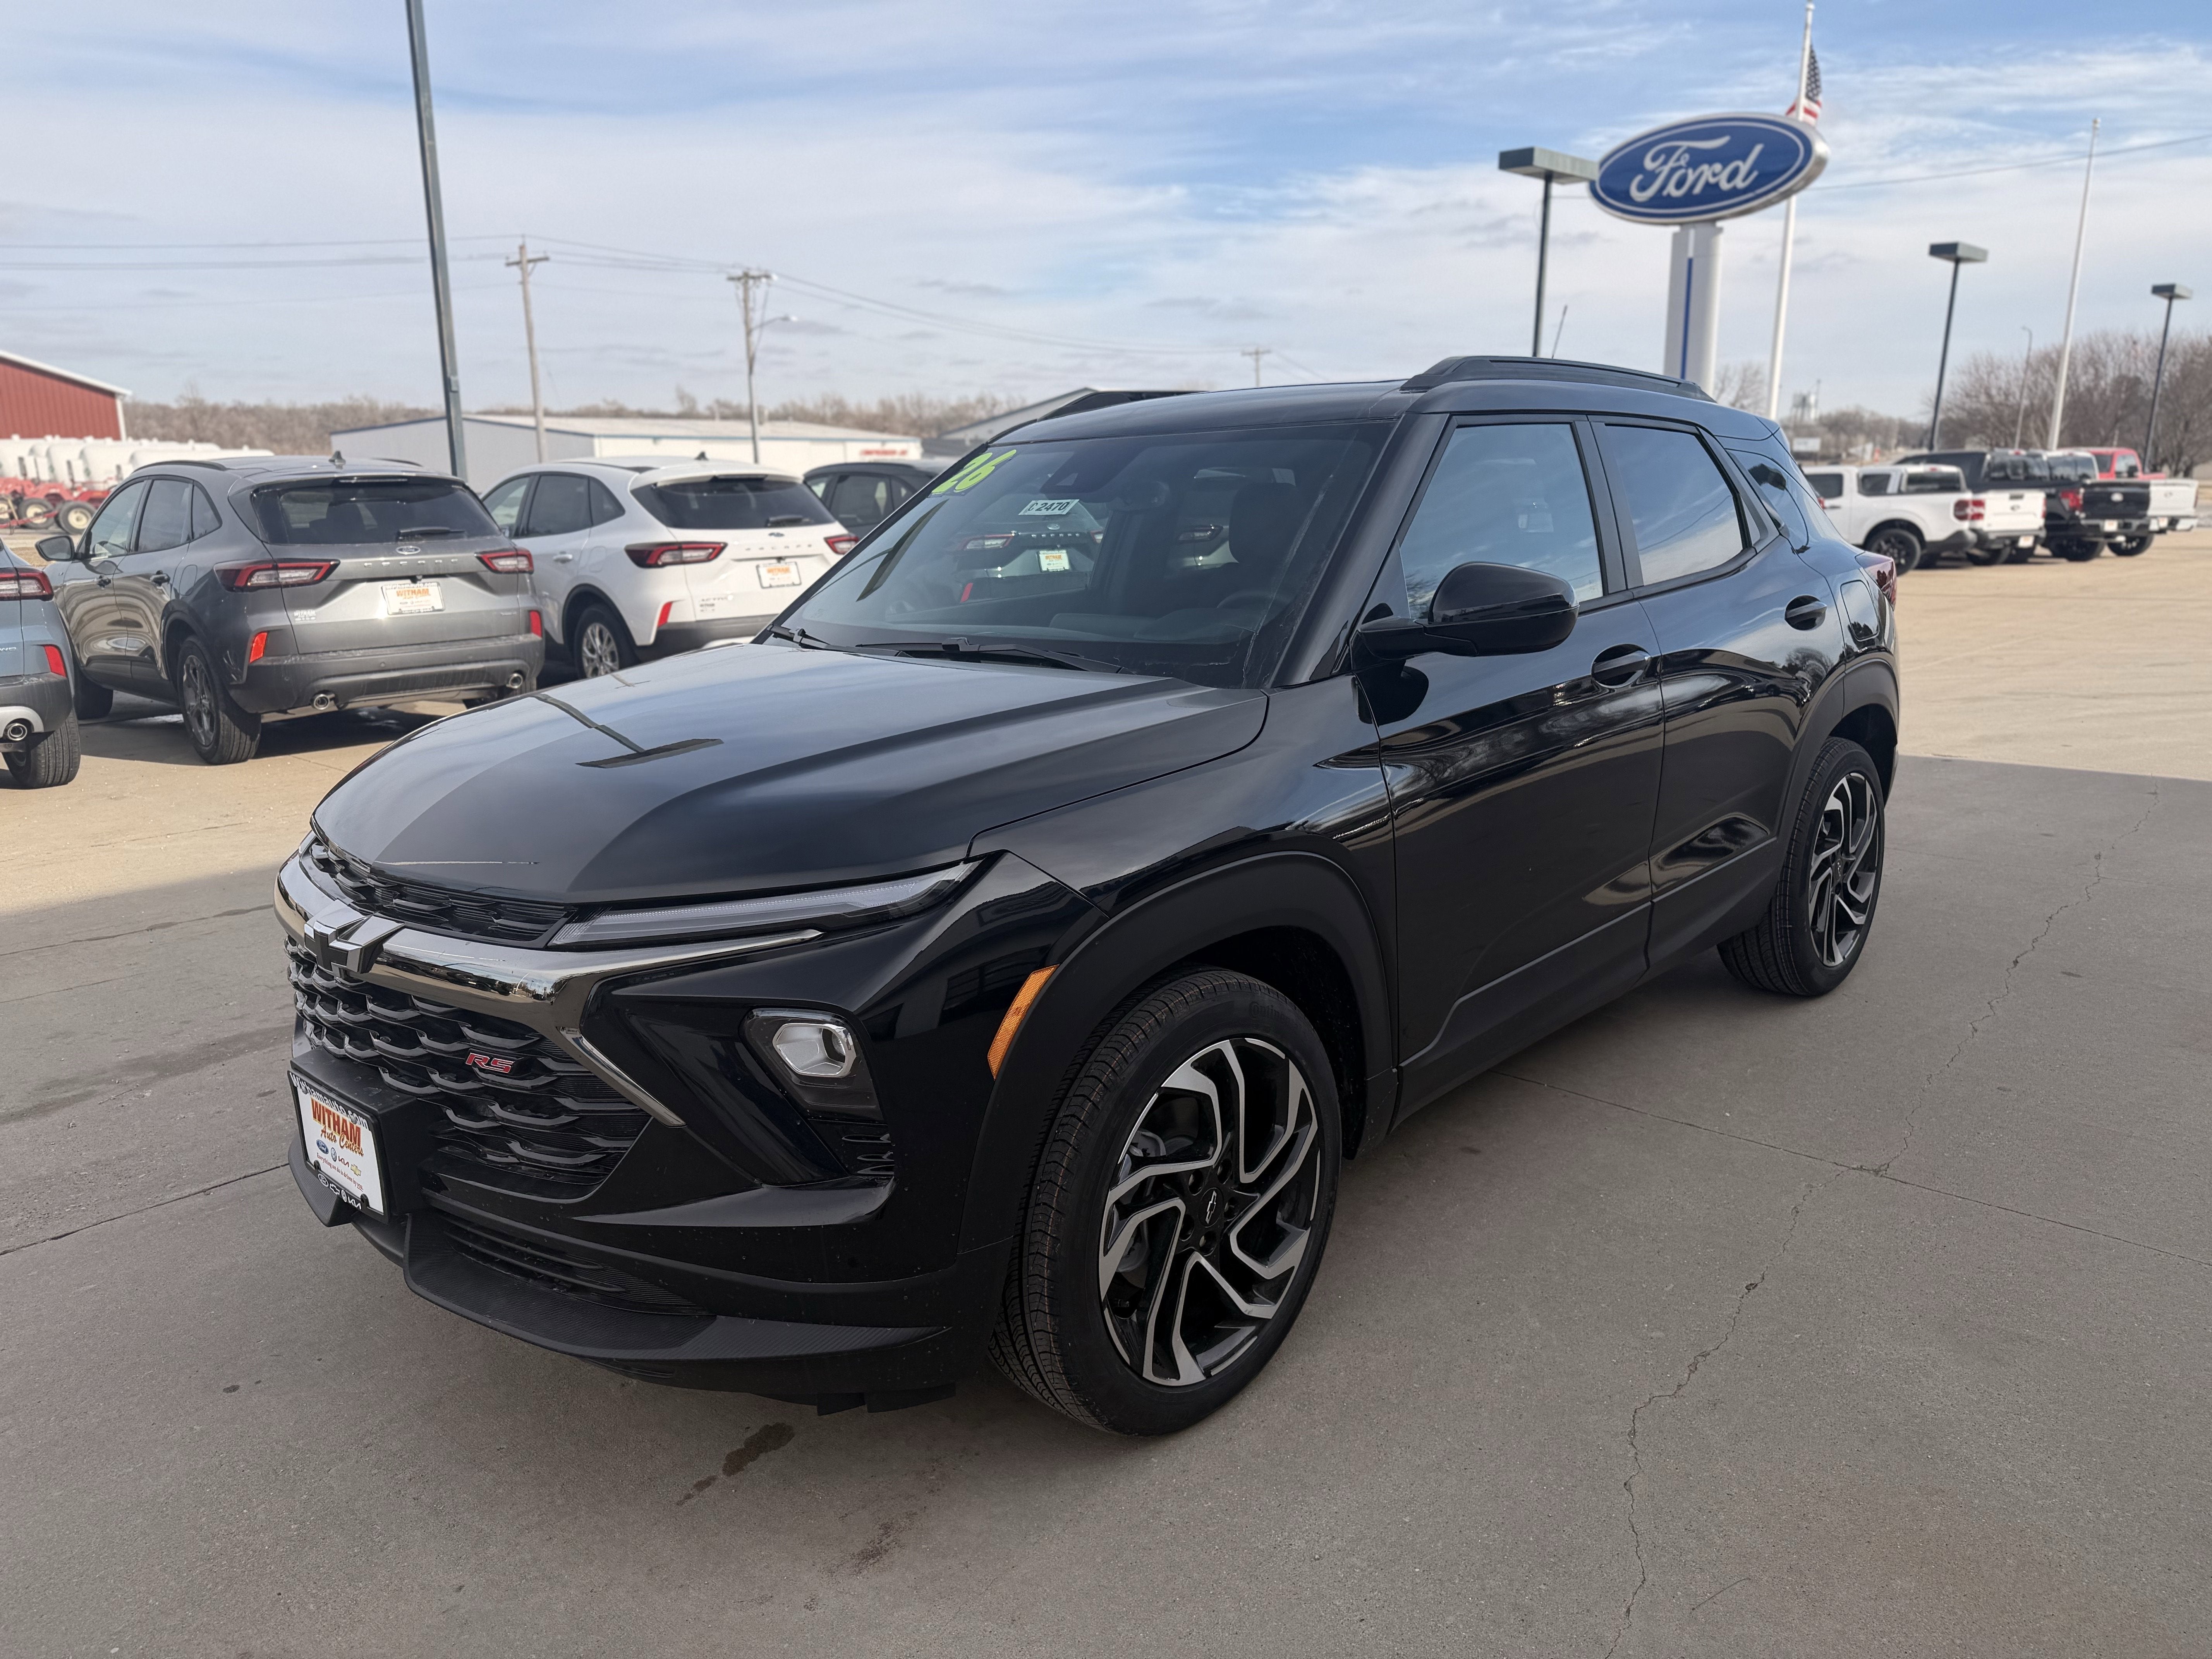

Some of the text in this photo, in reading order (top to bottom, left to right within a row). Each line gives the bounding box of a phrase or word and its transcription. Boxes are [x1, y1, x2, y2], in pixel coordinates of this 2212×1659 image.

[1630, 136, 1764, 202] Ford
[932, 450, 1016, 494] 26
[1028, 502, 1070, 511] C 2470
[397, 588, 429, 597] WITHAM
[465, 1053, 515, 1073] RS
[311, 1097, 361, 1148] WITHAM
[321, 1125, 364, 1156] Auto Centers
